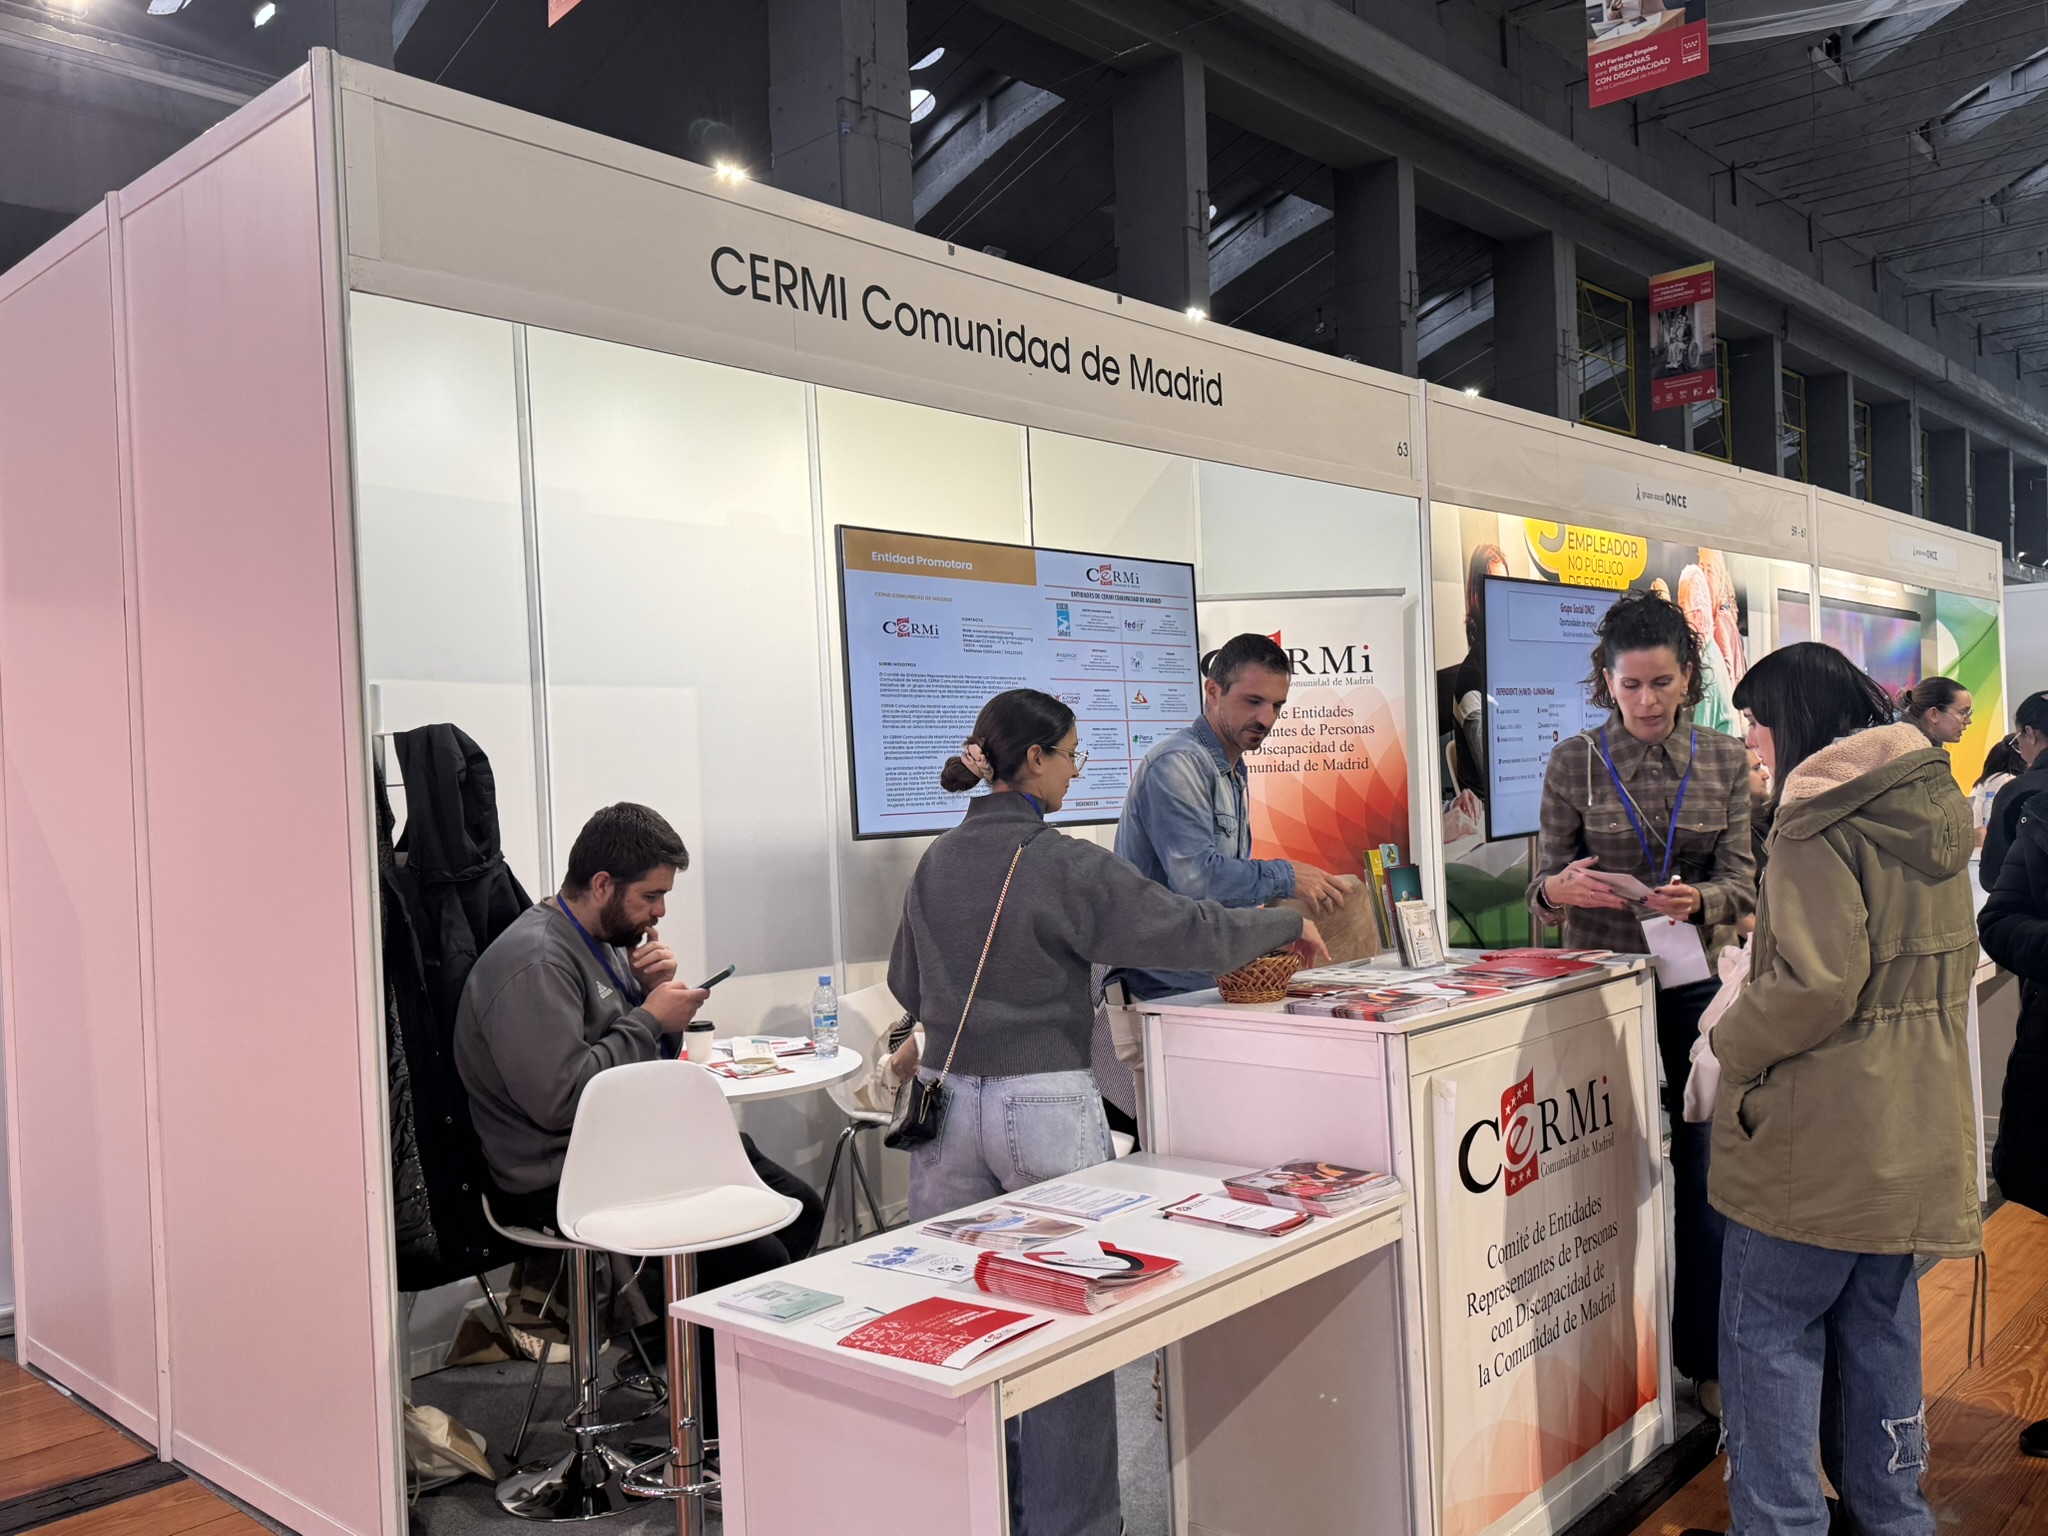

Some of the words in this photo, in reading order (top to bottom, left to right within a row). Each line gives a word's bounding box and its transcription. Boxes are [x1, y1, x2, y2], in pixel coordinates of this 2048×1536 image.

[1607, 55, 1624, 66] Feria
[1634, 45, 1658, 57] Empleo
[1608, 55, 1651, 73] PERSONAS
[1595, 75, 1612, 86] CON
[1613, 57, 1671, 80] DISCAPACIDAD
[710, 246, 847, 321] CERMI
[862, 284, 1070, 374] Comunidad
[1081, 344, 1120, 386] de
[1130, 353, 1223, 406] Madrid
[1397, 441, 1408, 457] 63
[1665, 492, 1687, 509] ONCE
[1568, 531, 1638, 559] EMPLEADOR
[872, 551, 915, 565] Entidad
[916, 555, 973, 571] Promotora
[1568, 555, 1583, 571] NO
[1585, 555, 1624, 576] PÚBLICO
[892, 593, 924, 601] COMUNIDAD
[1070, 591, 1095, 599] ENTIDADES
[1114, 594, 1139, 603] COMUNIDAD
[1560, 602, 1572, 616] Grupo
[1573, 604, 1584, 614] Social
[1584, 604, 1595, 615] ONCE
[1124, 620, 1143, 629] feder
[1289, 677, 1330, 688] omunidad
[1333, 677, 1343, 686] de
[1345, 676, 1374, 687] Madrid
[1292, 705, 1354, 719] Entidades
[1301, 724, 1316, 736] de
[1319, 723, 1375, 736] Personas
[1340, 740, 1355, 753] de
[1247, 759, 1300, 774] munidad
[1304, 758, 1319, 772] de
[1323, 757, 1369, 771] Madrid
[1541, 1150, 1580, 1178] Comunidad
[1581, 1144, 1590, 1160] de
[1591, 1132, 1615, 1156] Madrid
[1487, 1226, 1530, 1270] Comité
[1532, 1221, 1546, 1246] de
[1549, 1196, 1602, 1235] Entidades
[1467, 1253, 1555, 1318] Representantes
[1558, 1236, 1572, 1266] de
[1575, 1220, 1618, 1258] Personas
[1491, 1314, 1513, 1343] con
[1515, 1268, 1590, 1328] Discapacidad
[1593, 1260, 1606, 1286] de
[1478, 1363, 1491, 1389] la
[1494, 1311, 1560, 1378] Comunidad
[1563, 1308, 1578, 1335] de
[1581, 1282, 1617, 1327] Madrid
